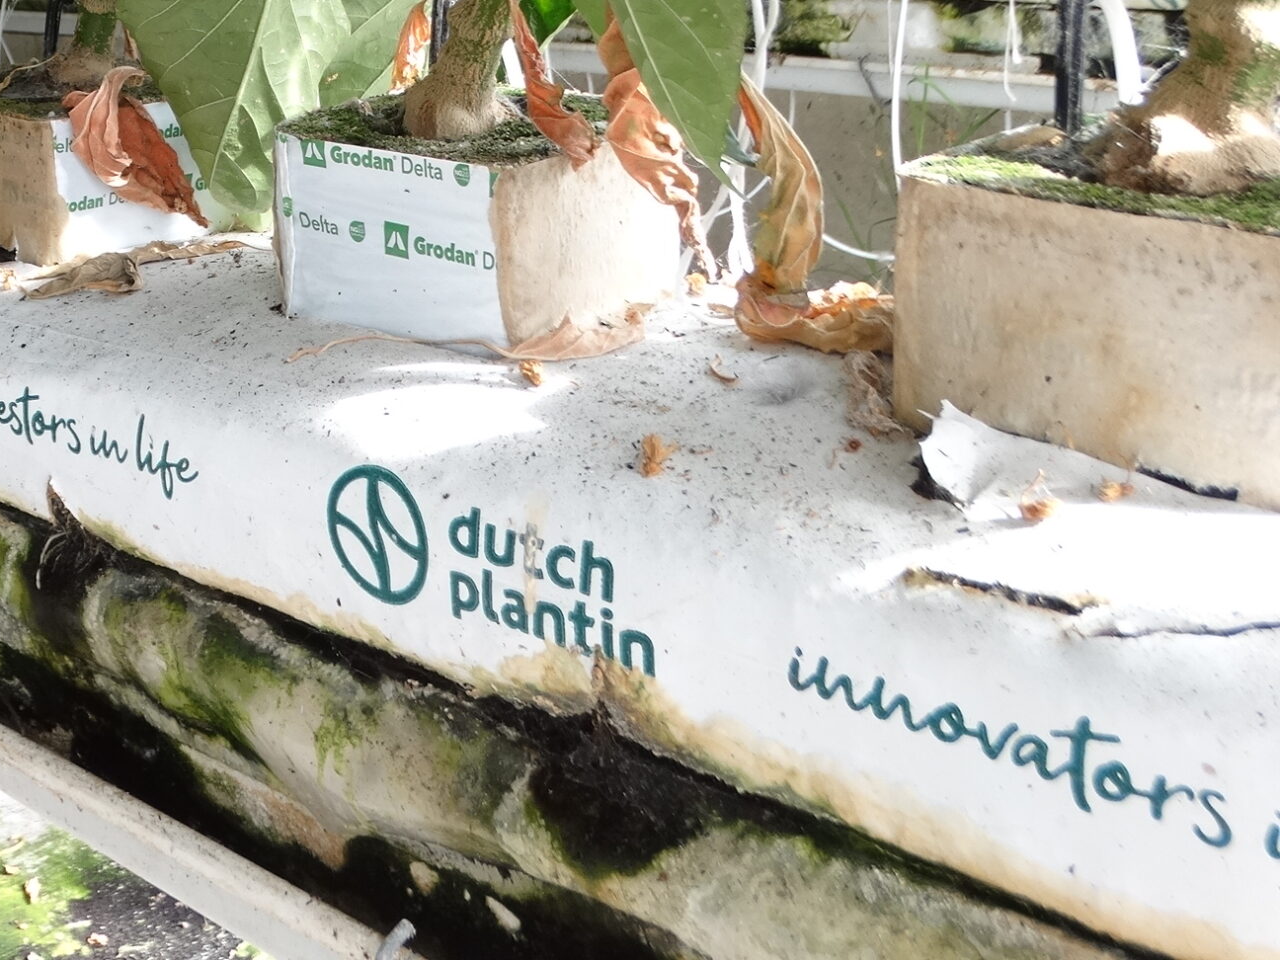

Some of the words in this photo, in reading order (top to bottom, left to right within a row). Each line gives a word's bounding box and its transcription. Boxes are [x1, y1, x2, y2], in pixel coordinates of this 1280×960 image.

[329, 145, 396, 172] Grodan
[400, 156, 444, 181] Delta
[298, 211, 339, 236] Delta
[413, 236, 477, 267] Grodan
[89, 424, 129, 464] in
[134, 413, 200, 501] life
[447, 506, 615, 603] dutch
[449, 568, 657, 678] plantin
[787, 646, 1233, 849] innovators
